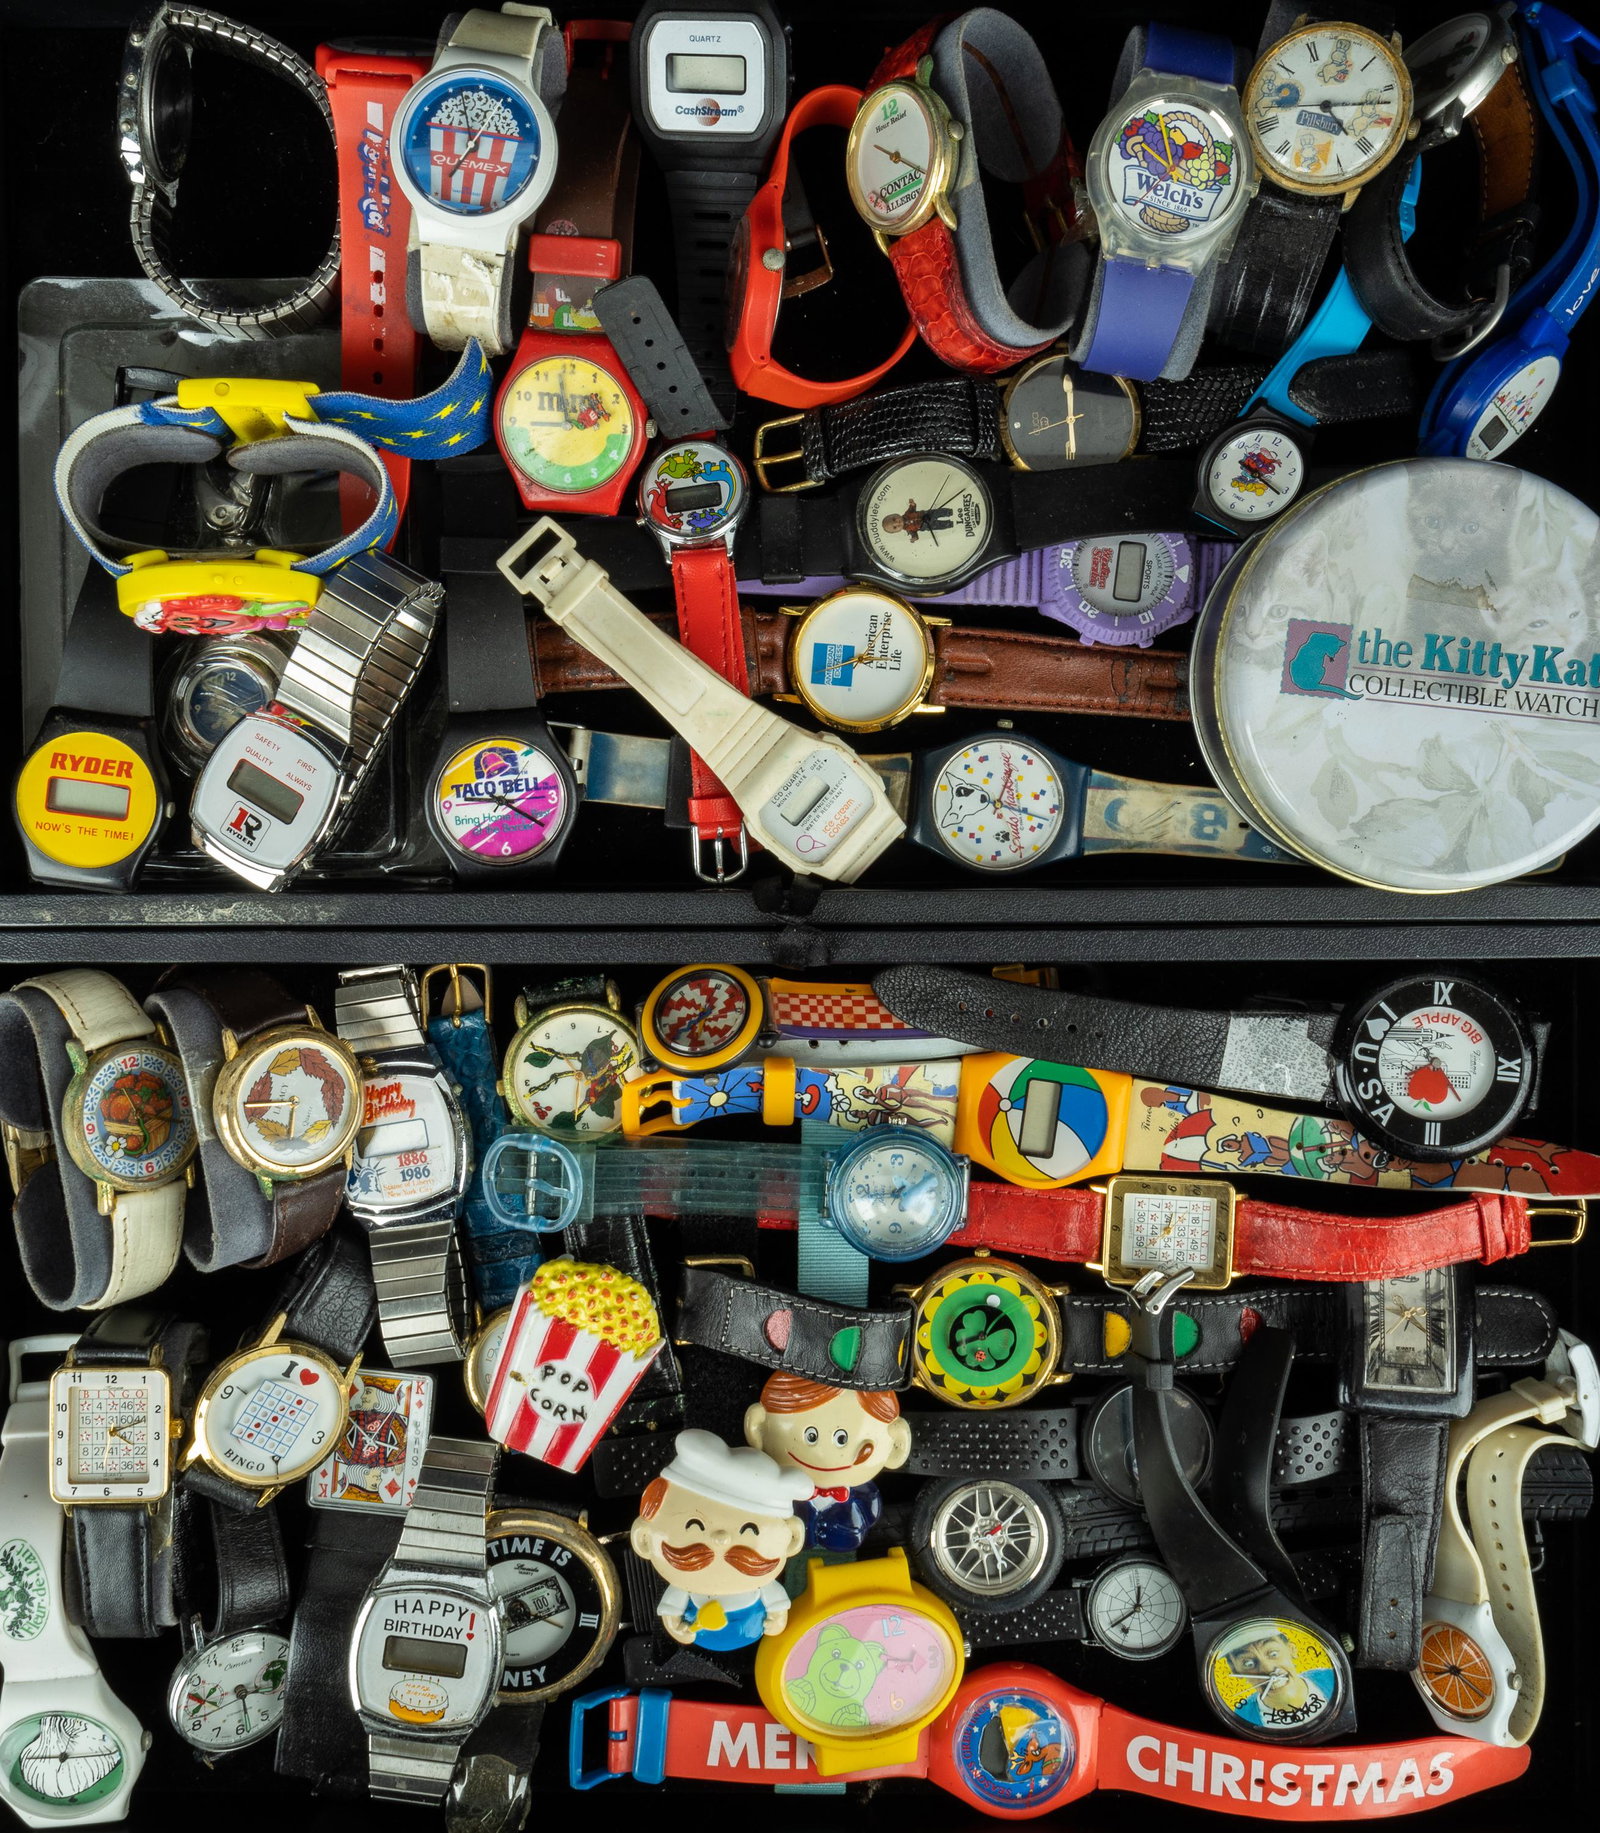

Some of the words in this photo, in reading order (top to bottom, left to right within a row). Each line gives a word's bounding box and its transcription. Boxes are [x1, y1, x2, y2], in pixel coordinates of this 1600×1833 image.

[689, 34, 721, 43] QUARTZ
[881, 98, 899, 122] 12
[875, 120, 890, 133] Hour
[890, 109, 907, 126] Relief
[433, 154, 508, 174] QUEMEX
[880, 169, 922, 199] CONTAC
[1137, 172, 1204, 209] Welch's
[886, 187, 921, 214] ALLERGY
[1150, 195, 1171, 208] SINCE
[1173, 204, 1188, 213] 1869
[1565, 267, 1600, 316] love
[516, 390, 532, 402] 10
[1271, 437, 1283, 447] 12
[563, 471, 572, 483] 6
[1288, 468, 1297, 476] 2
[869, 484, 896, 563] www.buddylee.com
[956, 507, 964, 525] Lee
[962, 493, 976, 538] DUNGAREES
[1060, 548, 1074, 569] 30
[1143, 559, 1153, 590] SPORTS
[1078, 600, 1100, 619] 20
[1138, 609, 1155, 625] 10
[875, 611, 893, 670] Enterprise
[1357, 628, 1413, 669] the
[888, 648, 902, 672] Life
[225, 671, 236, 682] 12
[1349, 673, 1508, 709] COLLECTIBLE
[254, 732, 282, 752] SAFETY
[50, 752, 134, 778] RYDER
[245, 745, 274, 767] QUALITY
[809, 758, 822, 771] DATE
[296, 758, 318, 775] FIRST
[285, 770, 313, 792] ALWAYS
[450, 780, 497, 799] TACO
[498, 776, 541, 794] BELL
[771, 790, 784, 805] LCD
[782, 766, 806, 792] QUARTZ
[548, 790, 558, 804] 3
[776, 791, 793, 808] MONTH
[796, 774, 807, 788] DATE
[442, 800, 453, 814] 9
[800, 814, 812, 828] HOUR
[812, 795, 830, 814] MINUTE
[805, 816, 819, 832] WATER
[820, 787, 846, 816] RESISTANT
[833, 798, 855, 822] cream
[454, 814, 480, 826] Bring
[482, 812, 511, 823] Home
[502, 820, 534, 833] Border
[828, 815, 850, 839] cones
[35, 821, 72, 834] NOW'S
[77, 826, 98, 837] THE
[104, 829, 134, 841] TIME!
[226, 825, 254, 847] RYDER
[501, 841, 512, 856] 6
[1411, 1012, 1462, 1029] APPLE
[1459, 1022, 1483, 1045] BIG
[120, 1056, 139, 1069] 12
[180, 1095, 189, 1108] 3
[364, 1081, 403, 1103] Happy
[361, 1098, 416, 1127] Birthday
[85, 1122, 96, 1136] 9
[145, 1161, 155, 1174] 6
[396, 1151, 428, 1168] 1886
[399, 1165, 431, 1183] 1986
[281, 1360, 299, 1378] I
[541, 1363, 590, 1394] POP
[71, 1374, 82, 1384] 11
[105, 1375, 118, 1384] 12
[414, 1381, 424, 1395] K
[220, 1385, 234, 1400] 9
[56, 1403, 67, 1413] 10
[121, 1401, 133, 1410] 46
[154, 1405, 162, 1414] 2
[529, 1388, 588, 1421] CORN
[57, 1431, 64, 1439] 9
[154, 1432, 161, 1441] 3
[311, 1430, 326, 1445] 3
[56, 1457, 63, 1466] 8
[152, 1458, 160, 1468] 4
[223, 1448, 265, 1472] BINGO
[71, 1486, 78, 1496] 7
[103, 1487, 110, 1496] 6
[137, 1487, 144, 1497] 5
[487, 1537, 545, 1558] TIME
[550, 1546, 573, 1567] IS
[394, 1599, 469, 1622] HAPPY
[881, 1613, 905, 1639] 12
[1306, 1645, 1322, 1659] 2
[502, 1665, 547, 1688] NEY
[404, 1682, 430, 1691] HAPPY
[405, 1689, 439, 1701] BIRTHDAY
[890, 1691, 904, 1712] 6
[1233, 1698, 1248, 1711] 8
[707, 1720, 819, 1770] MER
[1125, 1735, 1456, 1807] CHRISTMAS
